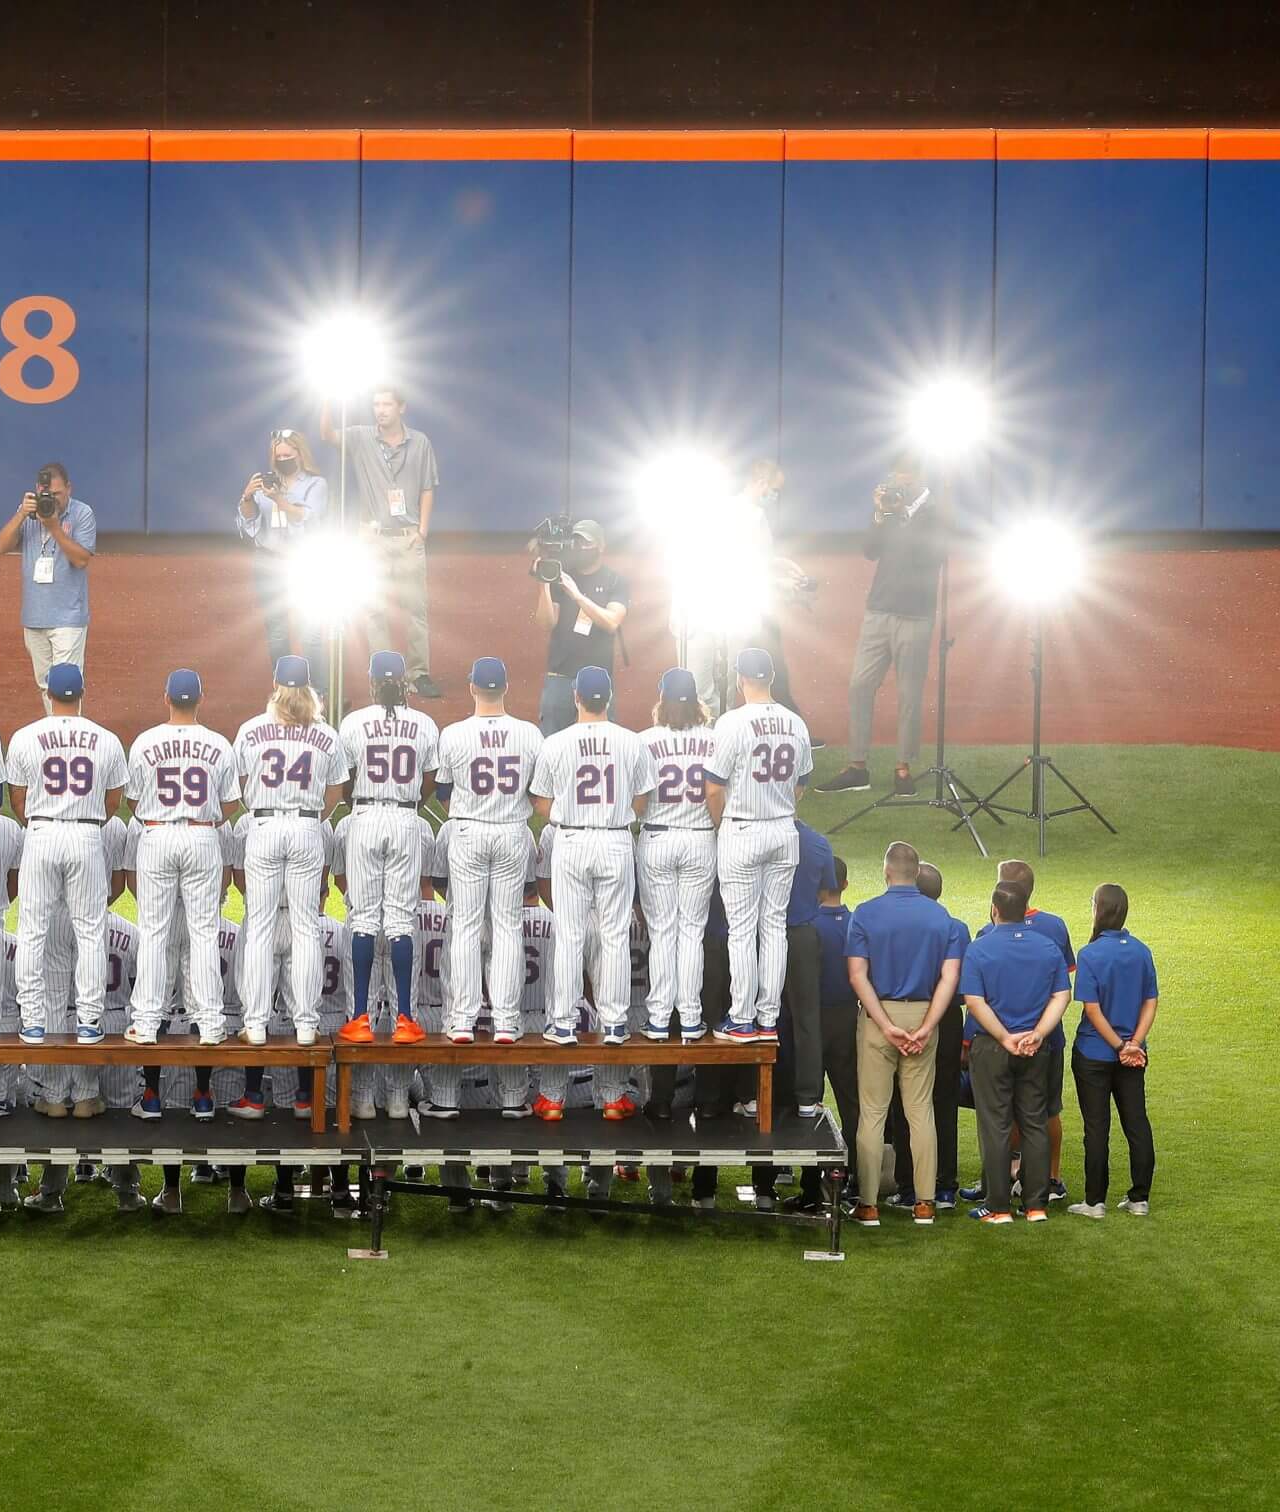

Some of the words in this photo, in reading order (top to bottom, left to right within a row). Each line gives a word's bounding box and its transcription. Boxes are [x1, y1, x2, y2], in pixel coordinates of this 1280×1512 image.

[37, 730, 99, 752] WALKER
[245, 722, 334, 752] SYNDERGAARD
[362, 719, 419, 741] CASTRO
[479, 730, 509, 750] MAY
[750, 716, 796, 738] MEGILL
[143, 740, 222, 767] CARRASCO
[366, 744, 417, 785] 50
[578, 737, 611, 757] HILL
[647, 737, 715, 761] WILLIAMS
[751, 743, 796, 784] 38
[42, 756, 94, 797] 99
[156, 766, 209, 807] 59
[260, 748, 313, 791] 34
[470, 755, 521, 796] 65
[576, 763, 616, 806] 21
[657, 763, 707, 804] 29
